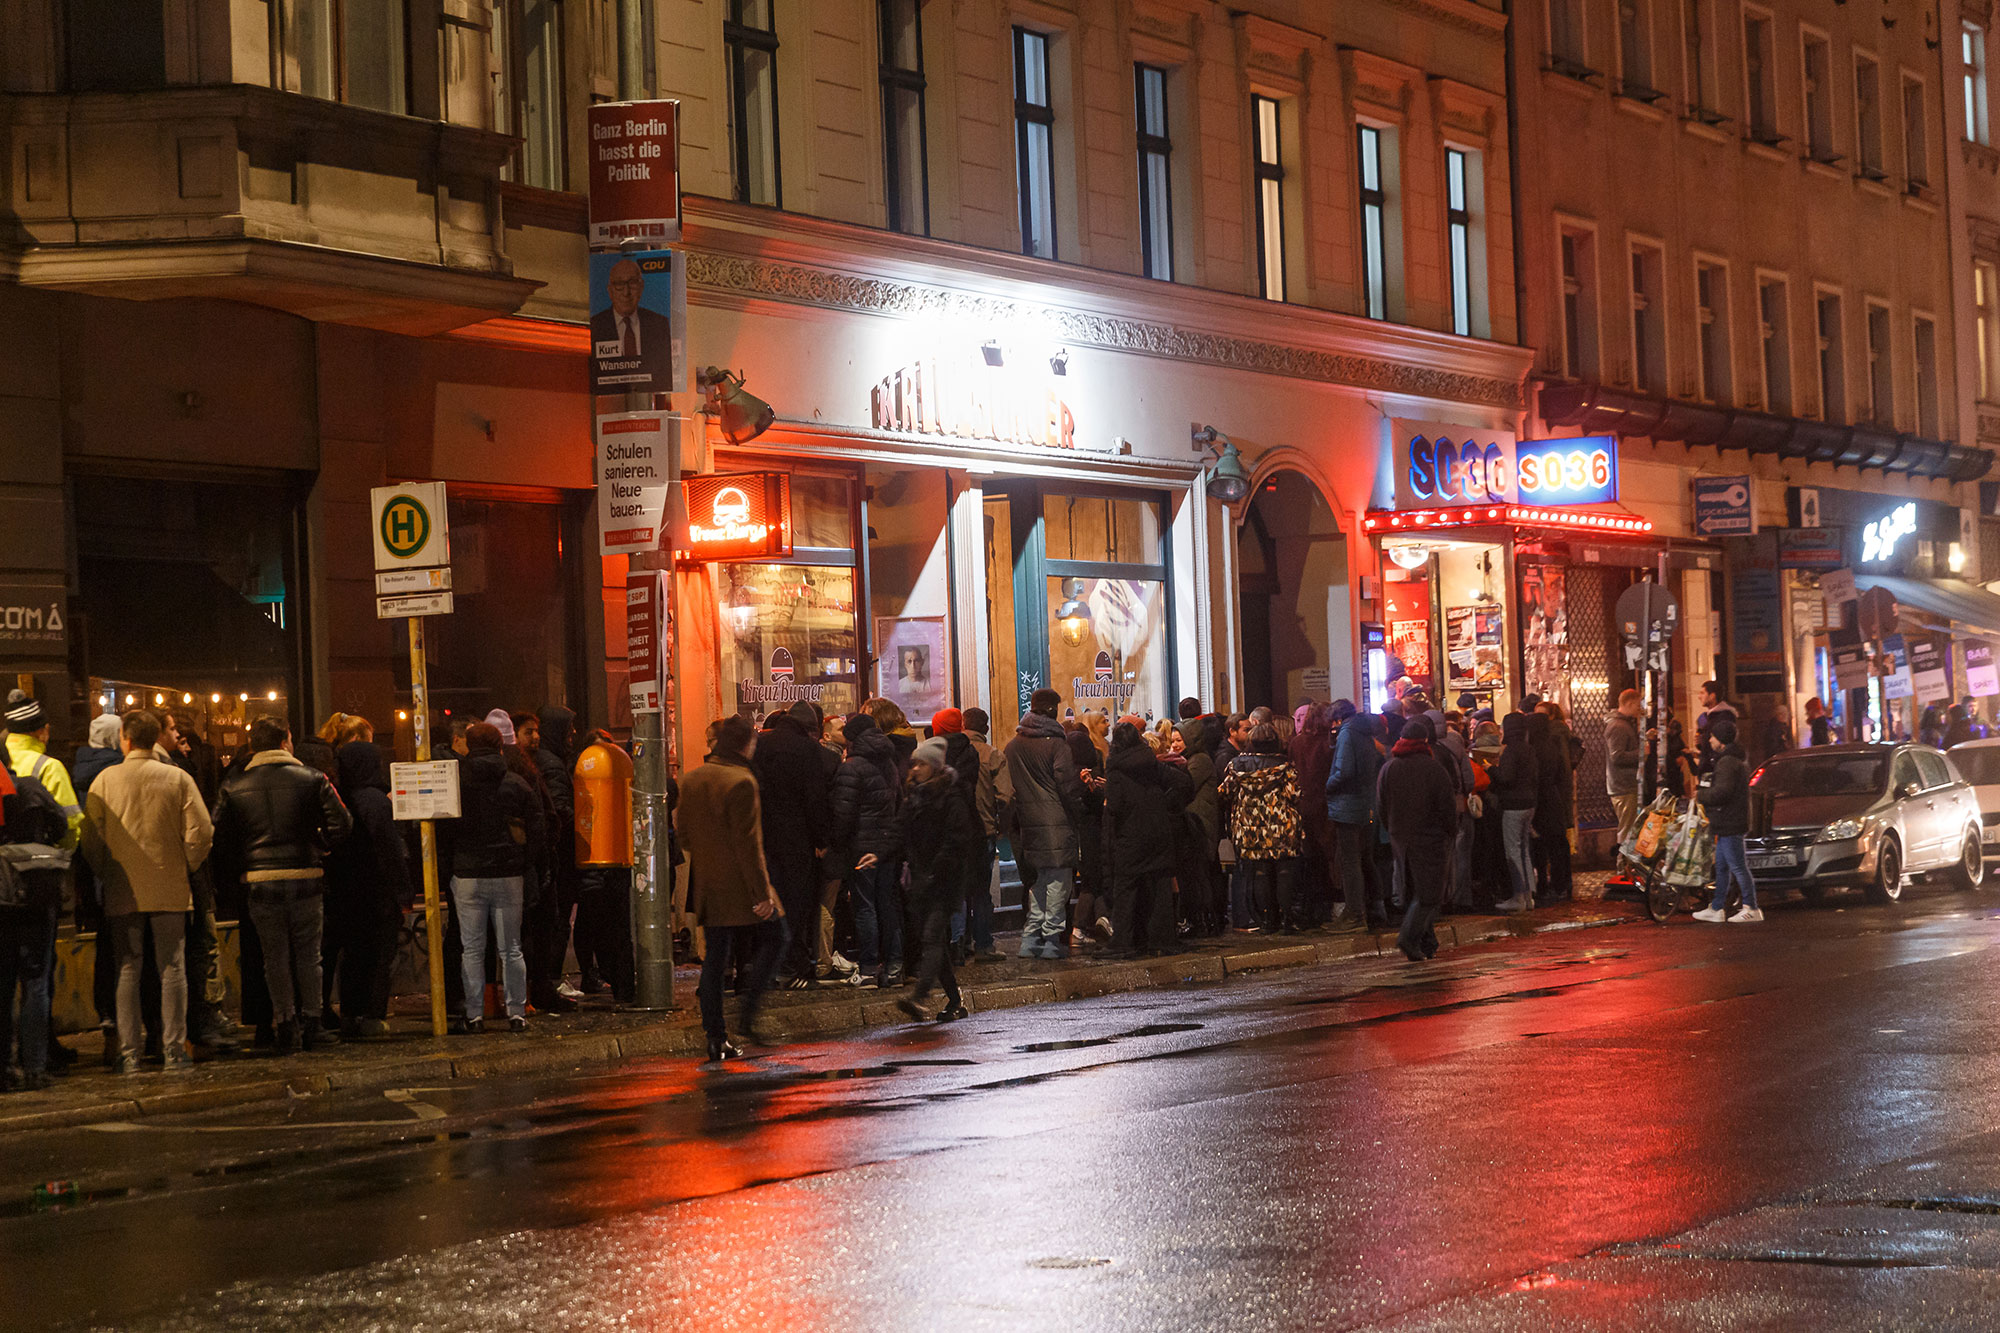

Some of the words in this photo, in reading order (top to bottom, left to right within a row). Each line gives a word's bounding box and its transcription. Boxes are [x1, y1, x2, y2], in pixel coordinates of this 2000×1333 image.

[593, 123, 621, 140] Ganz
[626, 119, 667, 137] Berlin
[599, 143, 634, 161] hasst
[639, 141, 661, 158] die
[608, 163, 650, 182] Politik
[609, 223, 665, 239] PARTEI
[642, 260, 666, 271] CDU
[598, 344, 619, 355] Kurt
[599, 360, 641, 371] Wansner
[606, 443, 652, 460] Schulen
[604, 463, 658, 480] sanieren.
[1518, 449, 1611, 493] SO36
[611, 483, 642, 498] Neue
[610, 502, 645, 518] bauen.
[391, 510, 415, 543] H
[1966, 647, 1990, 660] BAR
[741, 677, 824, 702] KreuzBurger
[1073, 677, 1136, 704] KreuzBurger
